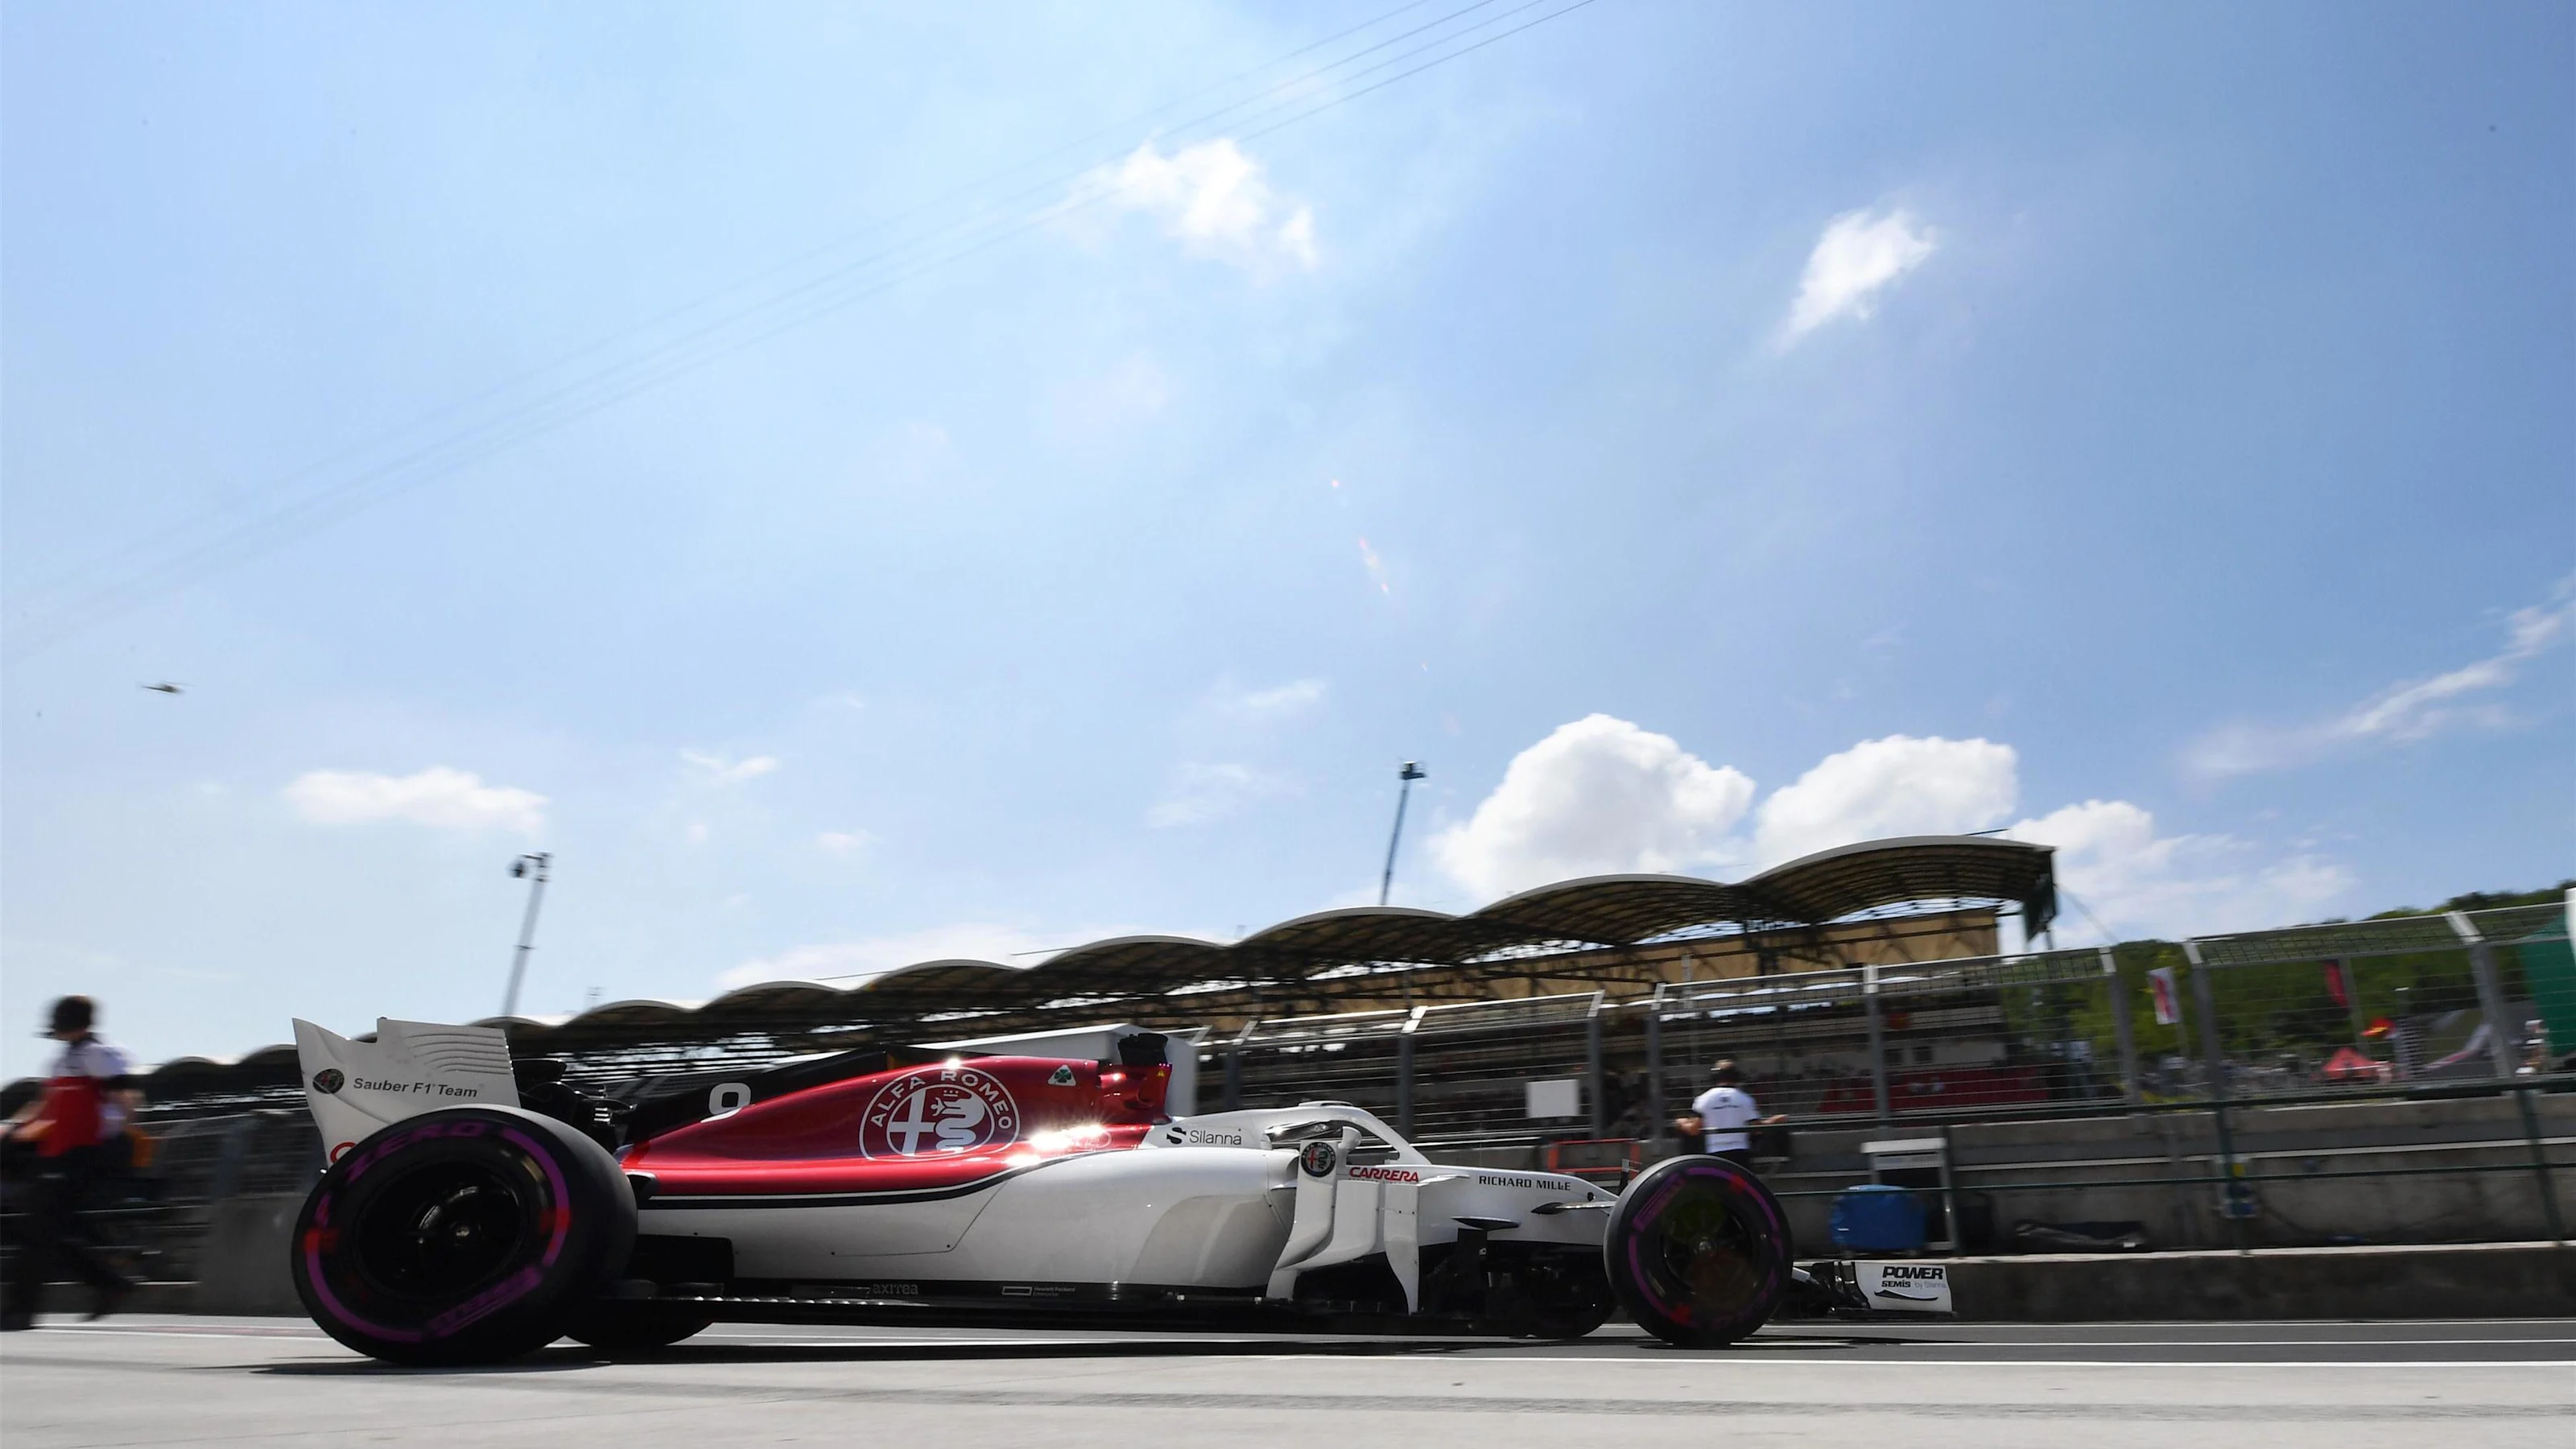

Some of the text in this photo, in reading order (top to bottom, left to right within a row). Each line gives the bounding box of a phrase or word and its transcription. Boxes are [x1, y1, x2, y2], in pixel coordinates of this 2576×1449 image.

[353, 1077, 409, 1092] Sauber
[438, 1084, 477, 1097] Team
[870, 1071, 1012, 1129] ALFA ROMEO
[1189, 1129, 1241, 1145] Silanna
[1349, 1166, 1418, 1182] CARRERA
[1479, 1175, 1571, 1191] RICHARD MILLE
[1882, 1266, 1943, 1280] POWER
